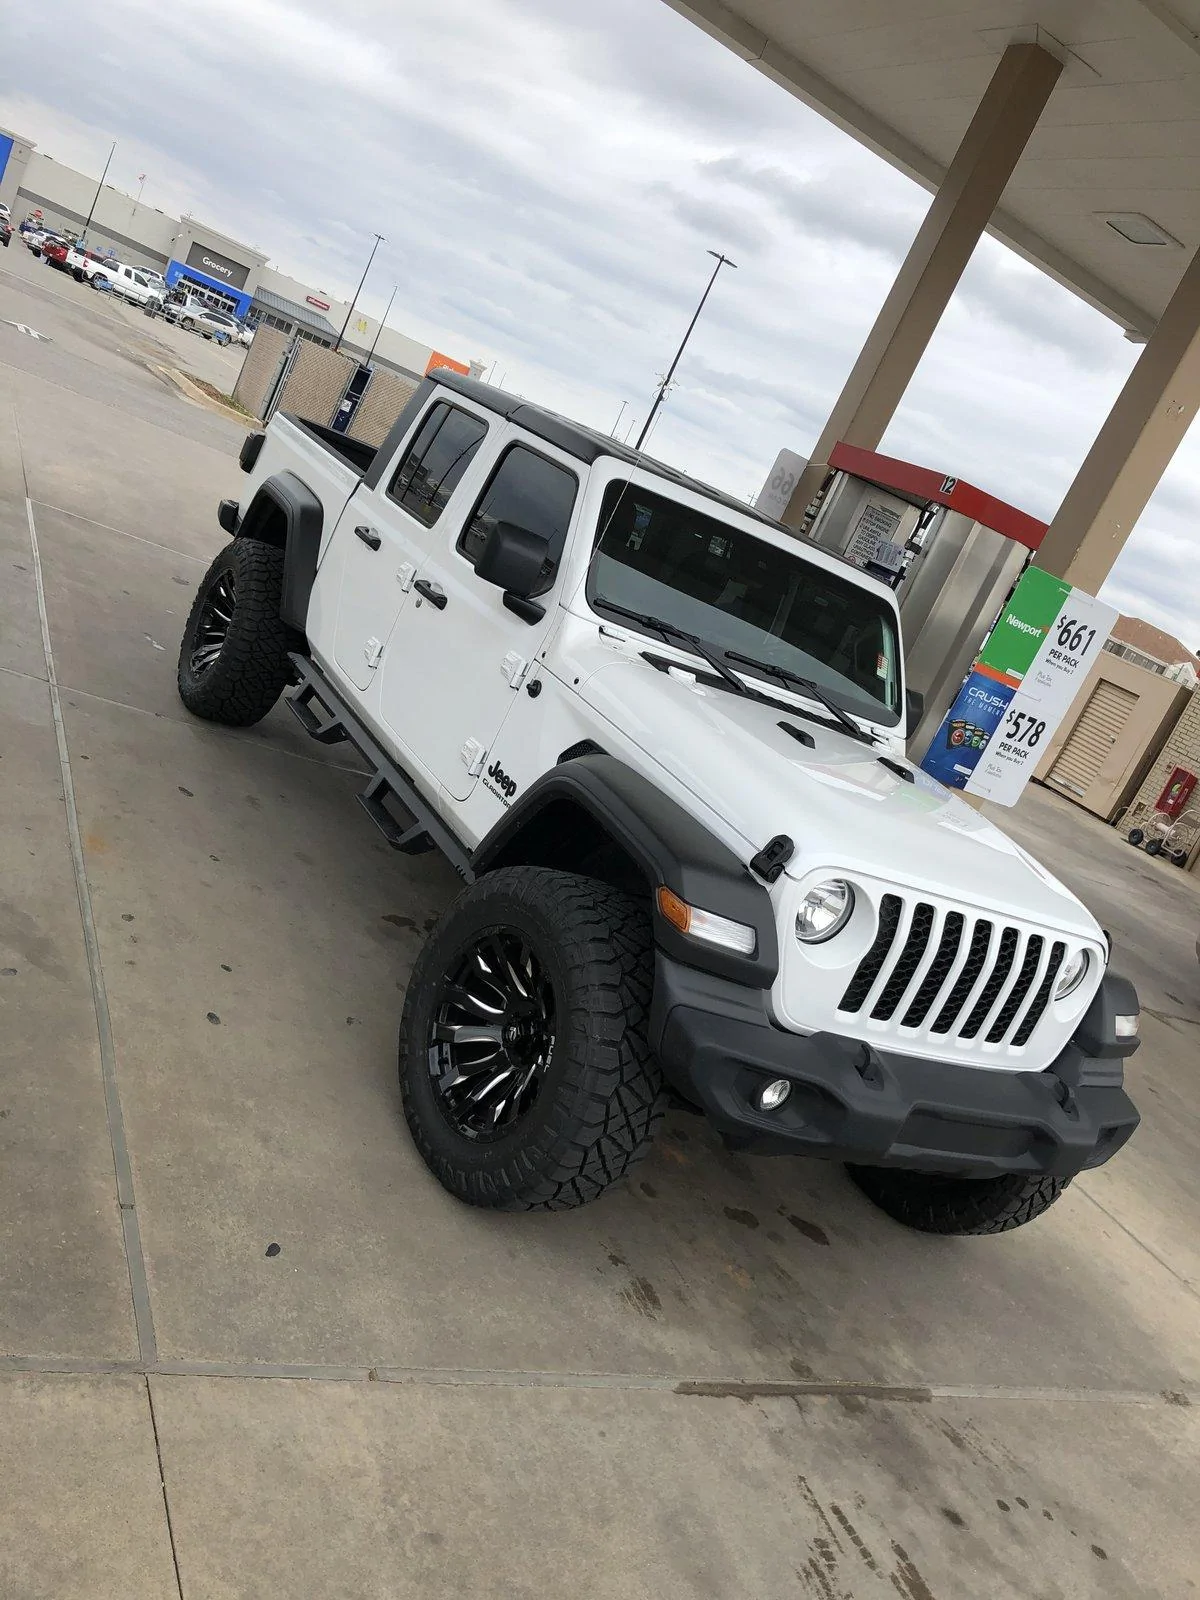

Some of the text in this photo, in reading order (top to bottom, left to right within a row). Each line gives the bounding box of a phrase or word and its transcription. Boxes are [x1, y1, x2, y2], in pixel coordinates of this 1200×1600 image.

[202, 256, 233, 278] Grocery
[941, 475, 956, 494] 12
[1005, 613, 1042, 639] Newport
[1045, 659, 1056, 668] When
[1048, 648, 1079, 669] PER PACK
[963, 695, 975, 706] THE
[968, 686, 1009, 710] CRUSH
[995, 750, 1006, 760] When
[998, 741, 1029, 760] PER PACK
[488, 760, 517, 798] Jeep
